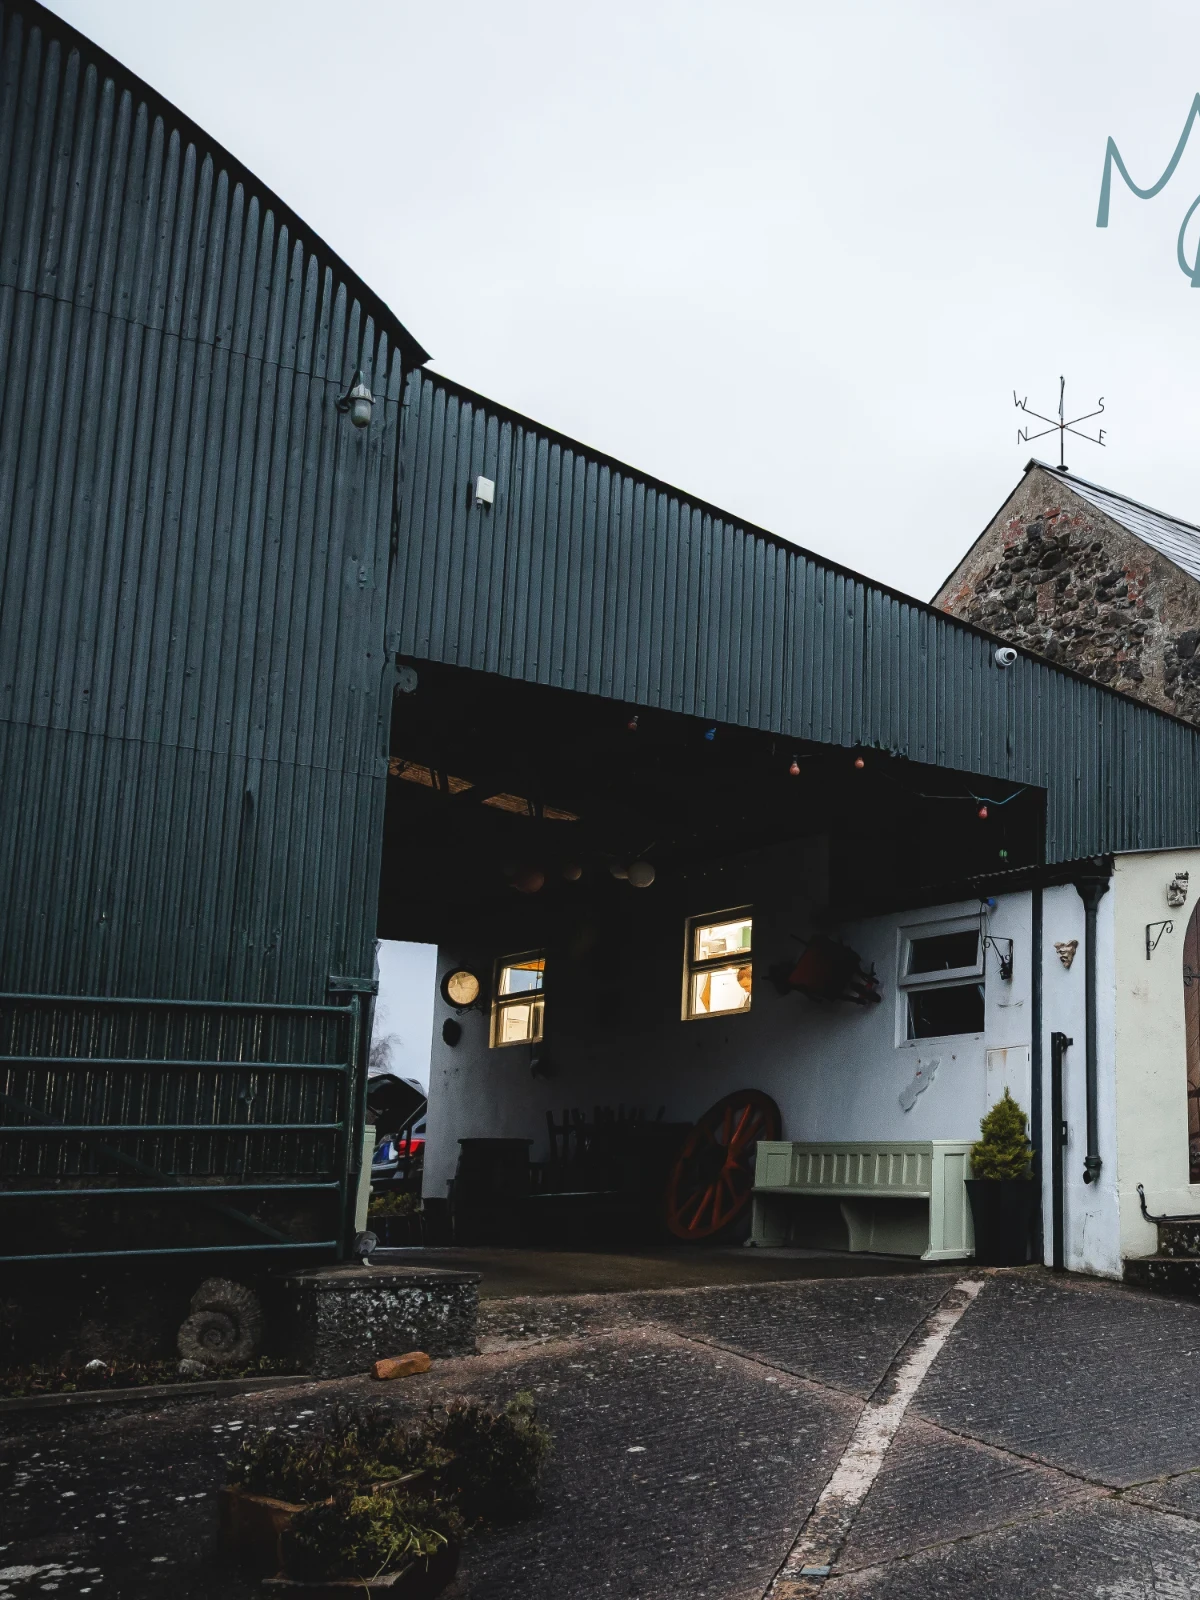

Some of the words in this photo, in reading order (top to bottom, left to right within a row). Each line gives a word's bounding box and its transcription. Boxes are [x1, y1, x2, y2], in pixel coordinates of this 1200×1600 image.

[1013, 389, 1027, 410] W
[1098, 396, 1105, 413] S
[1017, 426, 1028, 445] N
[1098, 428, 1107, 447] E
